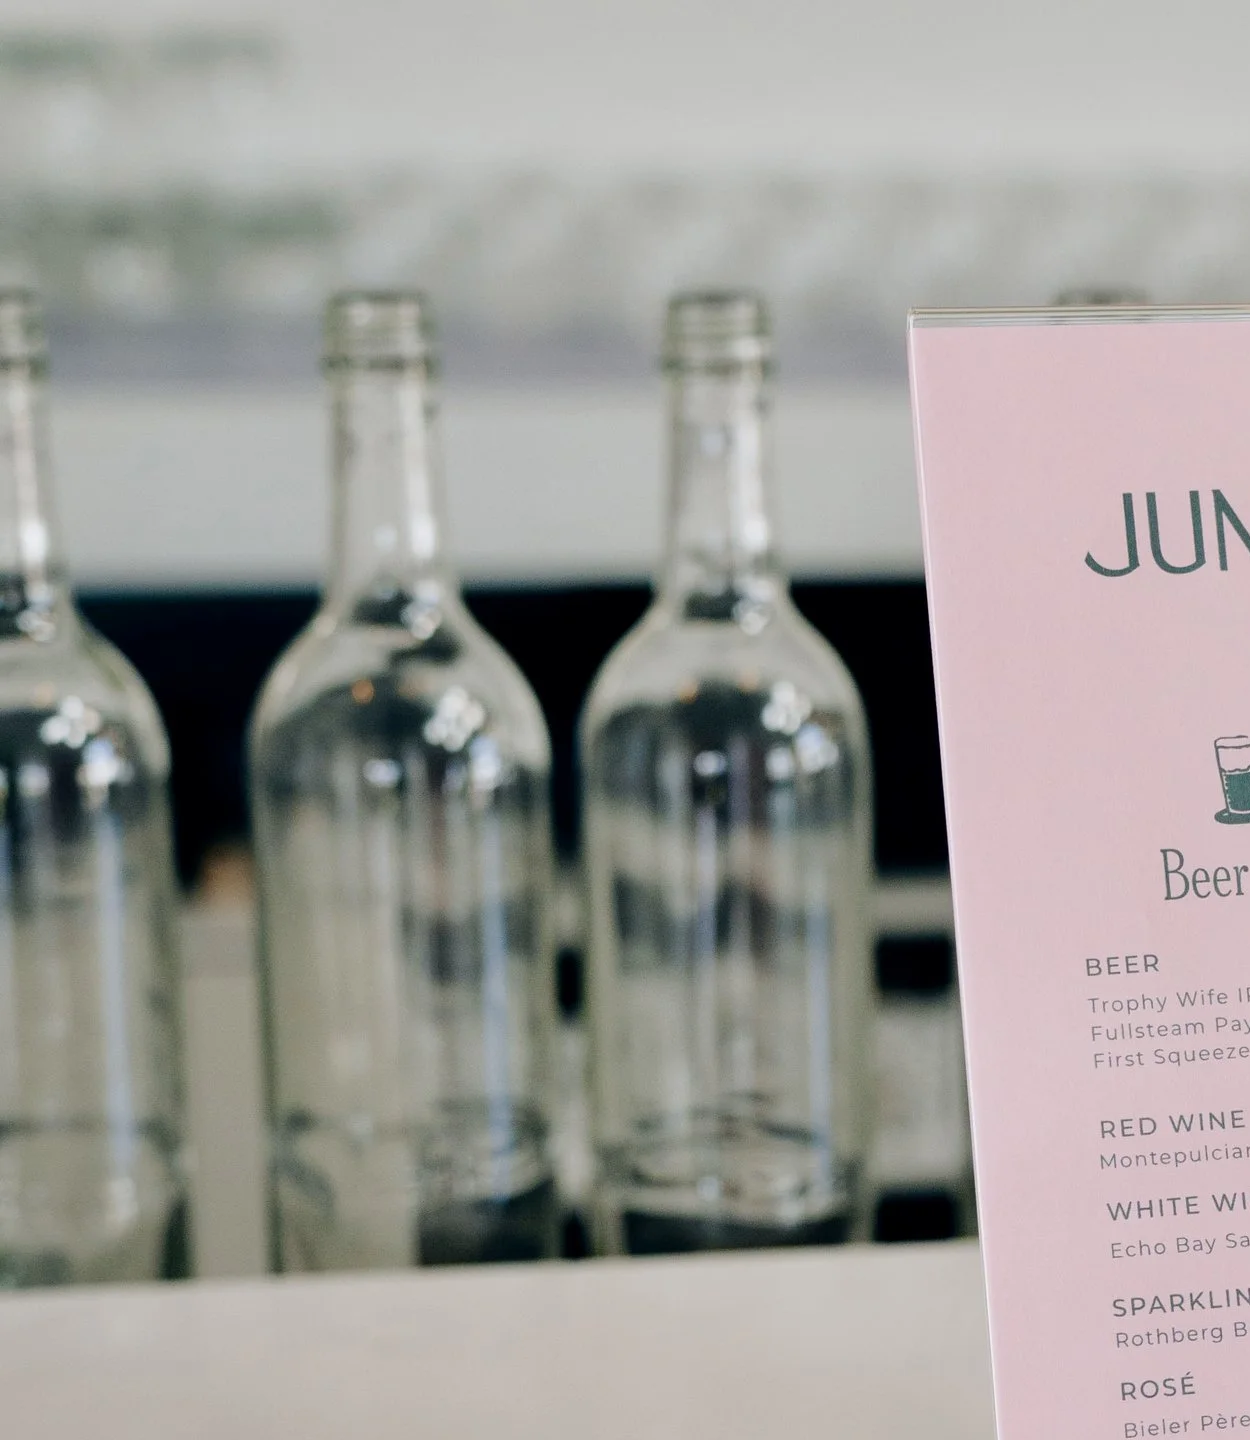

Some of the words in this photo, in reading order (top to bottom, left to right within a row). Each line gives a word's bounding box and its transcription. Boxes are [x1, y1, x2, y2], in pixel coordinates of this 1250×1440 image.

[1160, 849, 1248, 900] Beer
[1086, 954, 1159, 976] BEER
[1088, 994, 1166, 1014] Trophy
[1176, 989, 1228, 1007] Wife
[1092, 1022, 1204, 1041] Fullsteam
[1094, 1052, 1144, 1068] First
[1154, 1047, 1249, 1066] Squeeze
[1101, 1118, 1156, 1138] RED
[1169, 1110, 1245, 1133] WINE
[1107, 1196, 1199, 1221] WHITE
[1112, 1240, 1165, 1258] Echo
[1177, 1237, 1216, 1254] Bay
[1116, 1327, 1222, 1348] Rothberg
[1121, 1372, 1195, 1400] ROSÉ
[1125, 1419, 1189, 1438] Bieler
[1201, 1414, 1250, 1431] Père
